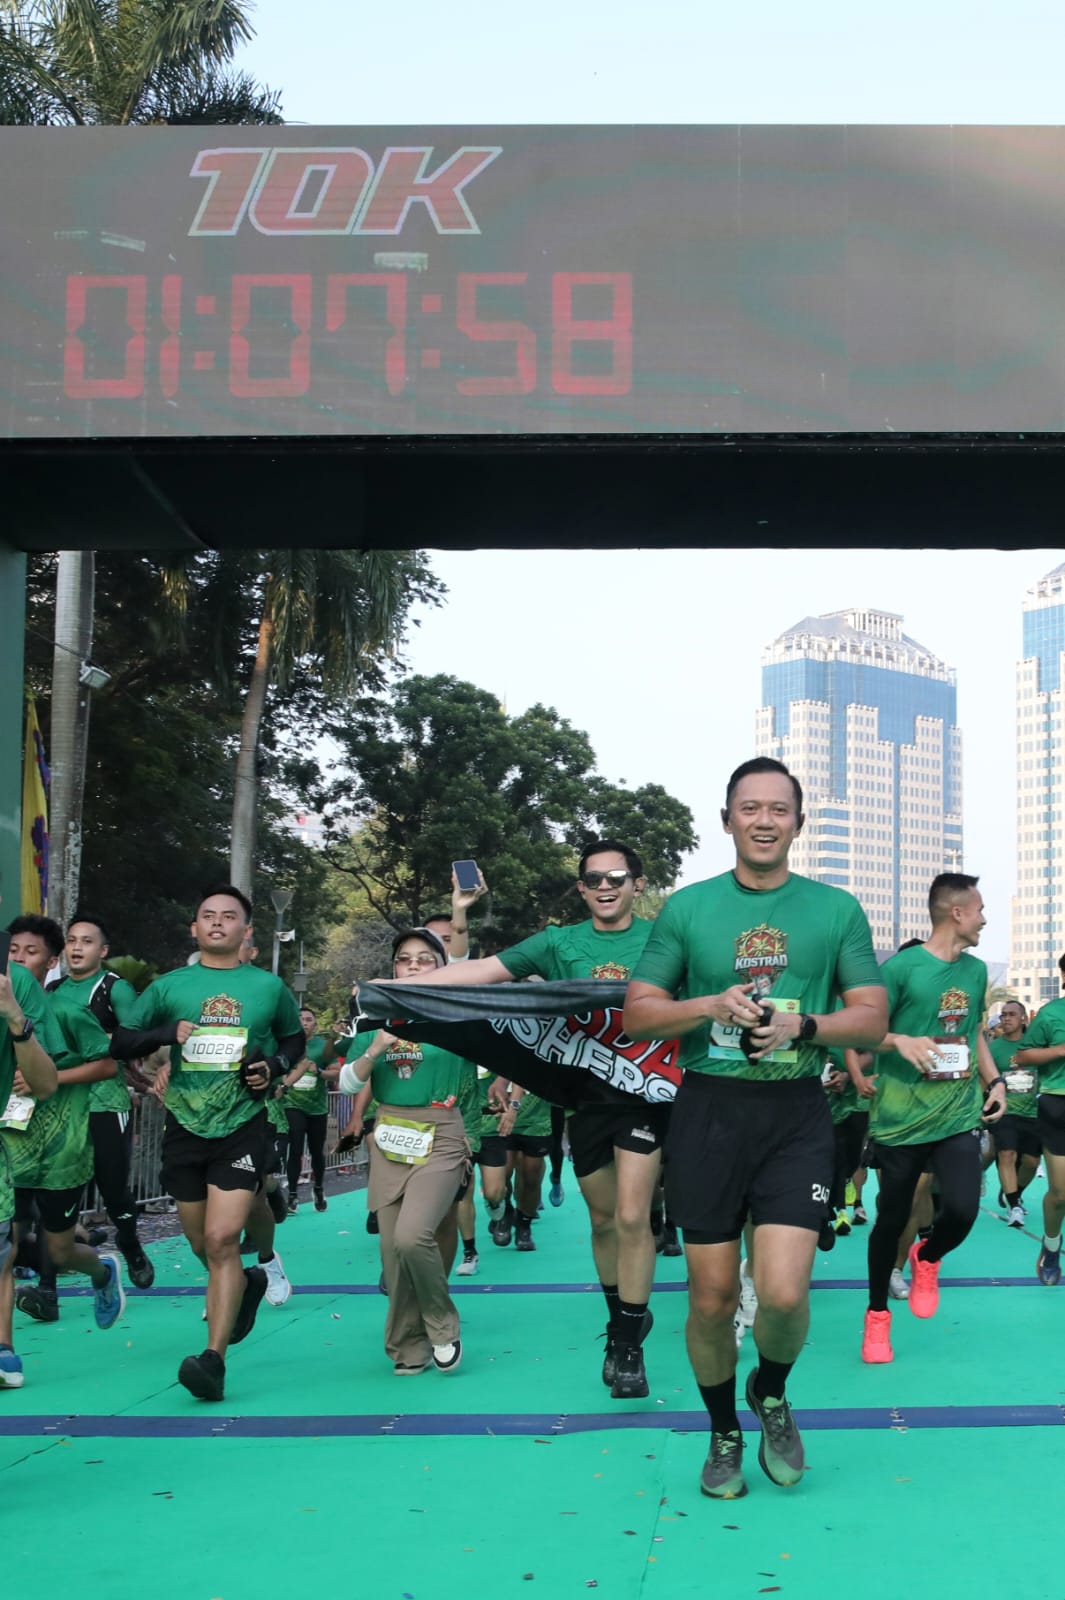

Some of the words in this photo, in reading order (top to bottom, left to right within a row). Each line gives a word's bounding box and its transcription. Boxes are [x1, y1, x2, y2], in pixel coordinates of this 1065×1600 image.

[188, 146, 503, 236] 10K
[63, 272, 634, 399] 01:07:58
[735, 954, 788, 970] KOSTRAD
[200, 1015, 240, 1025] KOSTRAD
[192, 1043, 234, 1055] 10026
[385, 1052, 423, 1061] KOSTRAD
[487, 1015, 679, 1102] SHERS
[380, 1131, 424, 1149] 34222
